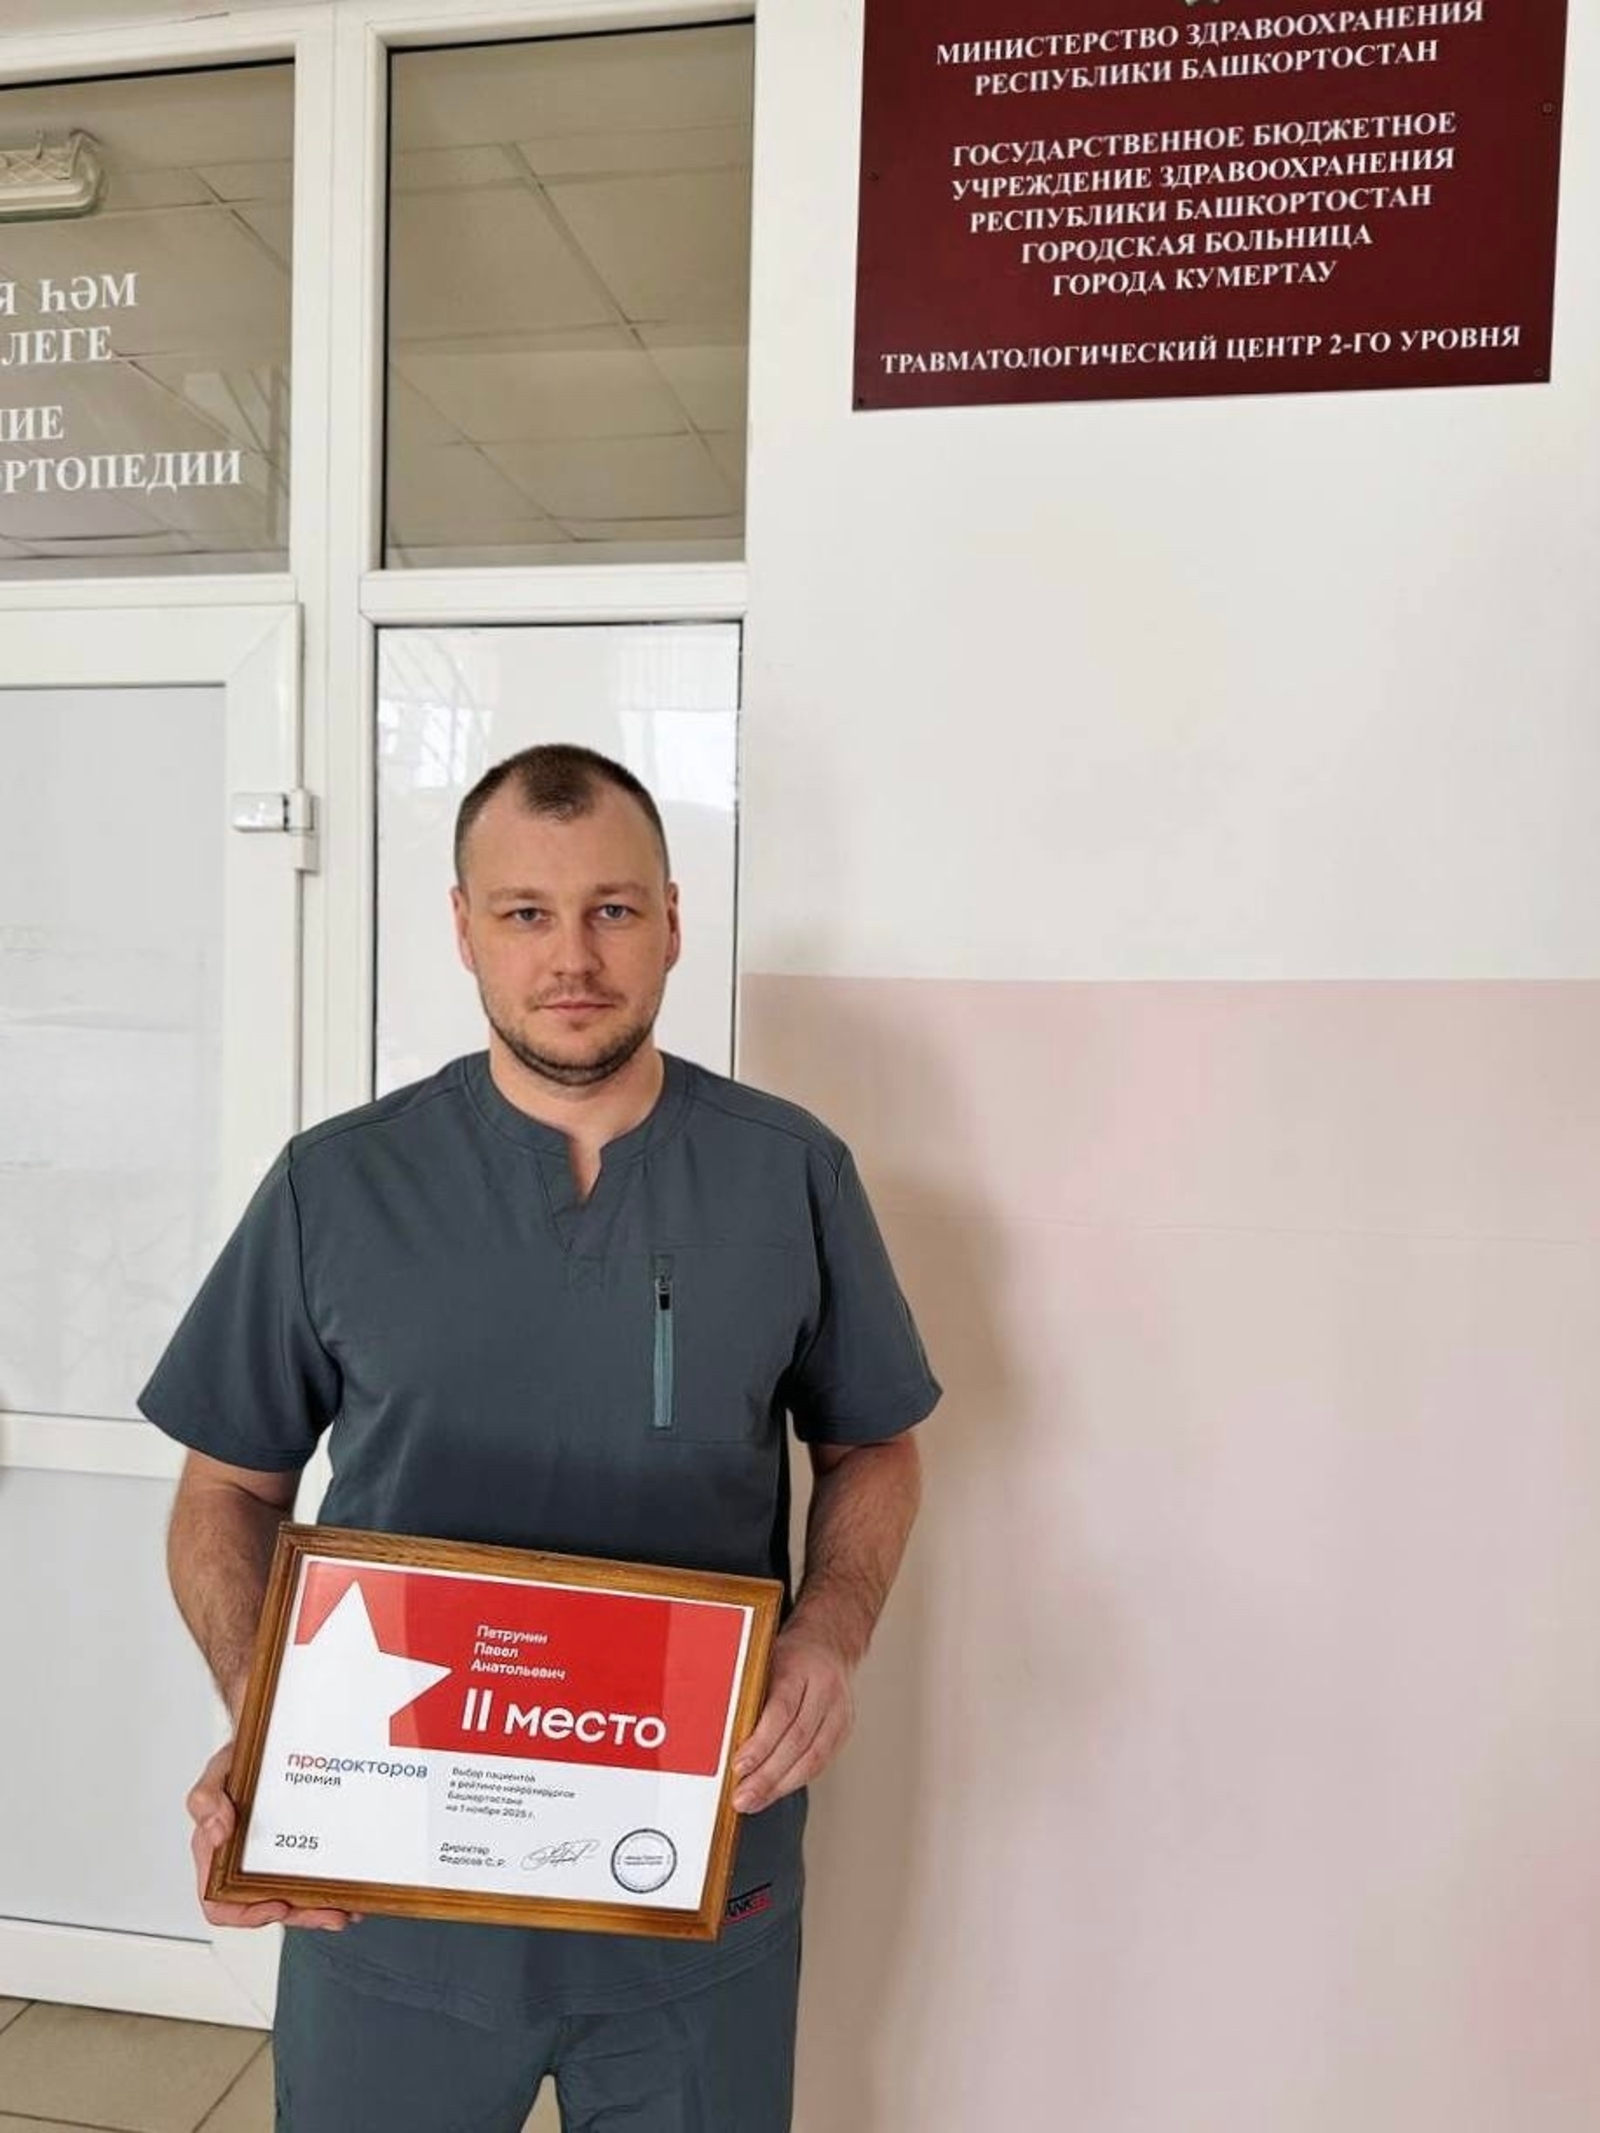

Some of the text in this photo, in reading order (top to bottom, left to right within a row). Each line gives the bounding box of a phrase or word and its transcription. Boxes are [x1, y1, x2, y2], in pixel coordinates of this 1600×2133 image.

[936, 0, 1484, 65] МИНИСТЕРСТВО ЗДРАВООХРАНЕНИЯ
[975, 39, 1438, 96] РЕСПУБЛИКИ БАШКОРТОСТАН
[953, 111, 1457, 167] ГОСУДАРСТВЕННОЕ БЮДЖЕТНОЕ
[952, 147, 1455, 201] УЧРЕЖДЕНИЕ ЗДРАВООХРАНЕНИЯ
[970, 184, 1434, 233] РЕСПУБЛИКИ БАШКОРТОСТАН
[1021, 224, 1373, 264] ГОРОДСКАЯ БОЛЬНИЦА
[1053, 260, 1337, 297] ГОРОДА КУМЕРТАУ
[881, 325, 1520, 374] ТРАВМАТОЛОГИЧЕСКИЙ ЦЕНТР 2-ГО УРОВНЯ
[0, 450, 242, 494] РТОПЕДИИ
[474, 1642, 518, 1658] Павел
[477, 1625, 548, 1644] Петрунин
[471, 1659, 566, 1680] Анатольевич
[503, 1703, 667, 1749] место
[285, 1772, 341, 1786] премия
[287, 1753, 428, 1778] продокторов
[275, 1834, 319, 1850] 2025
